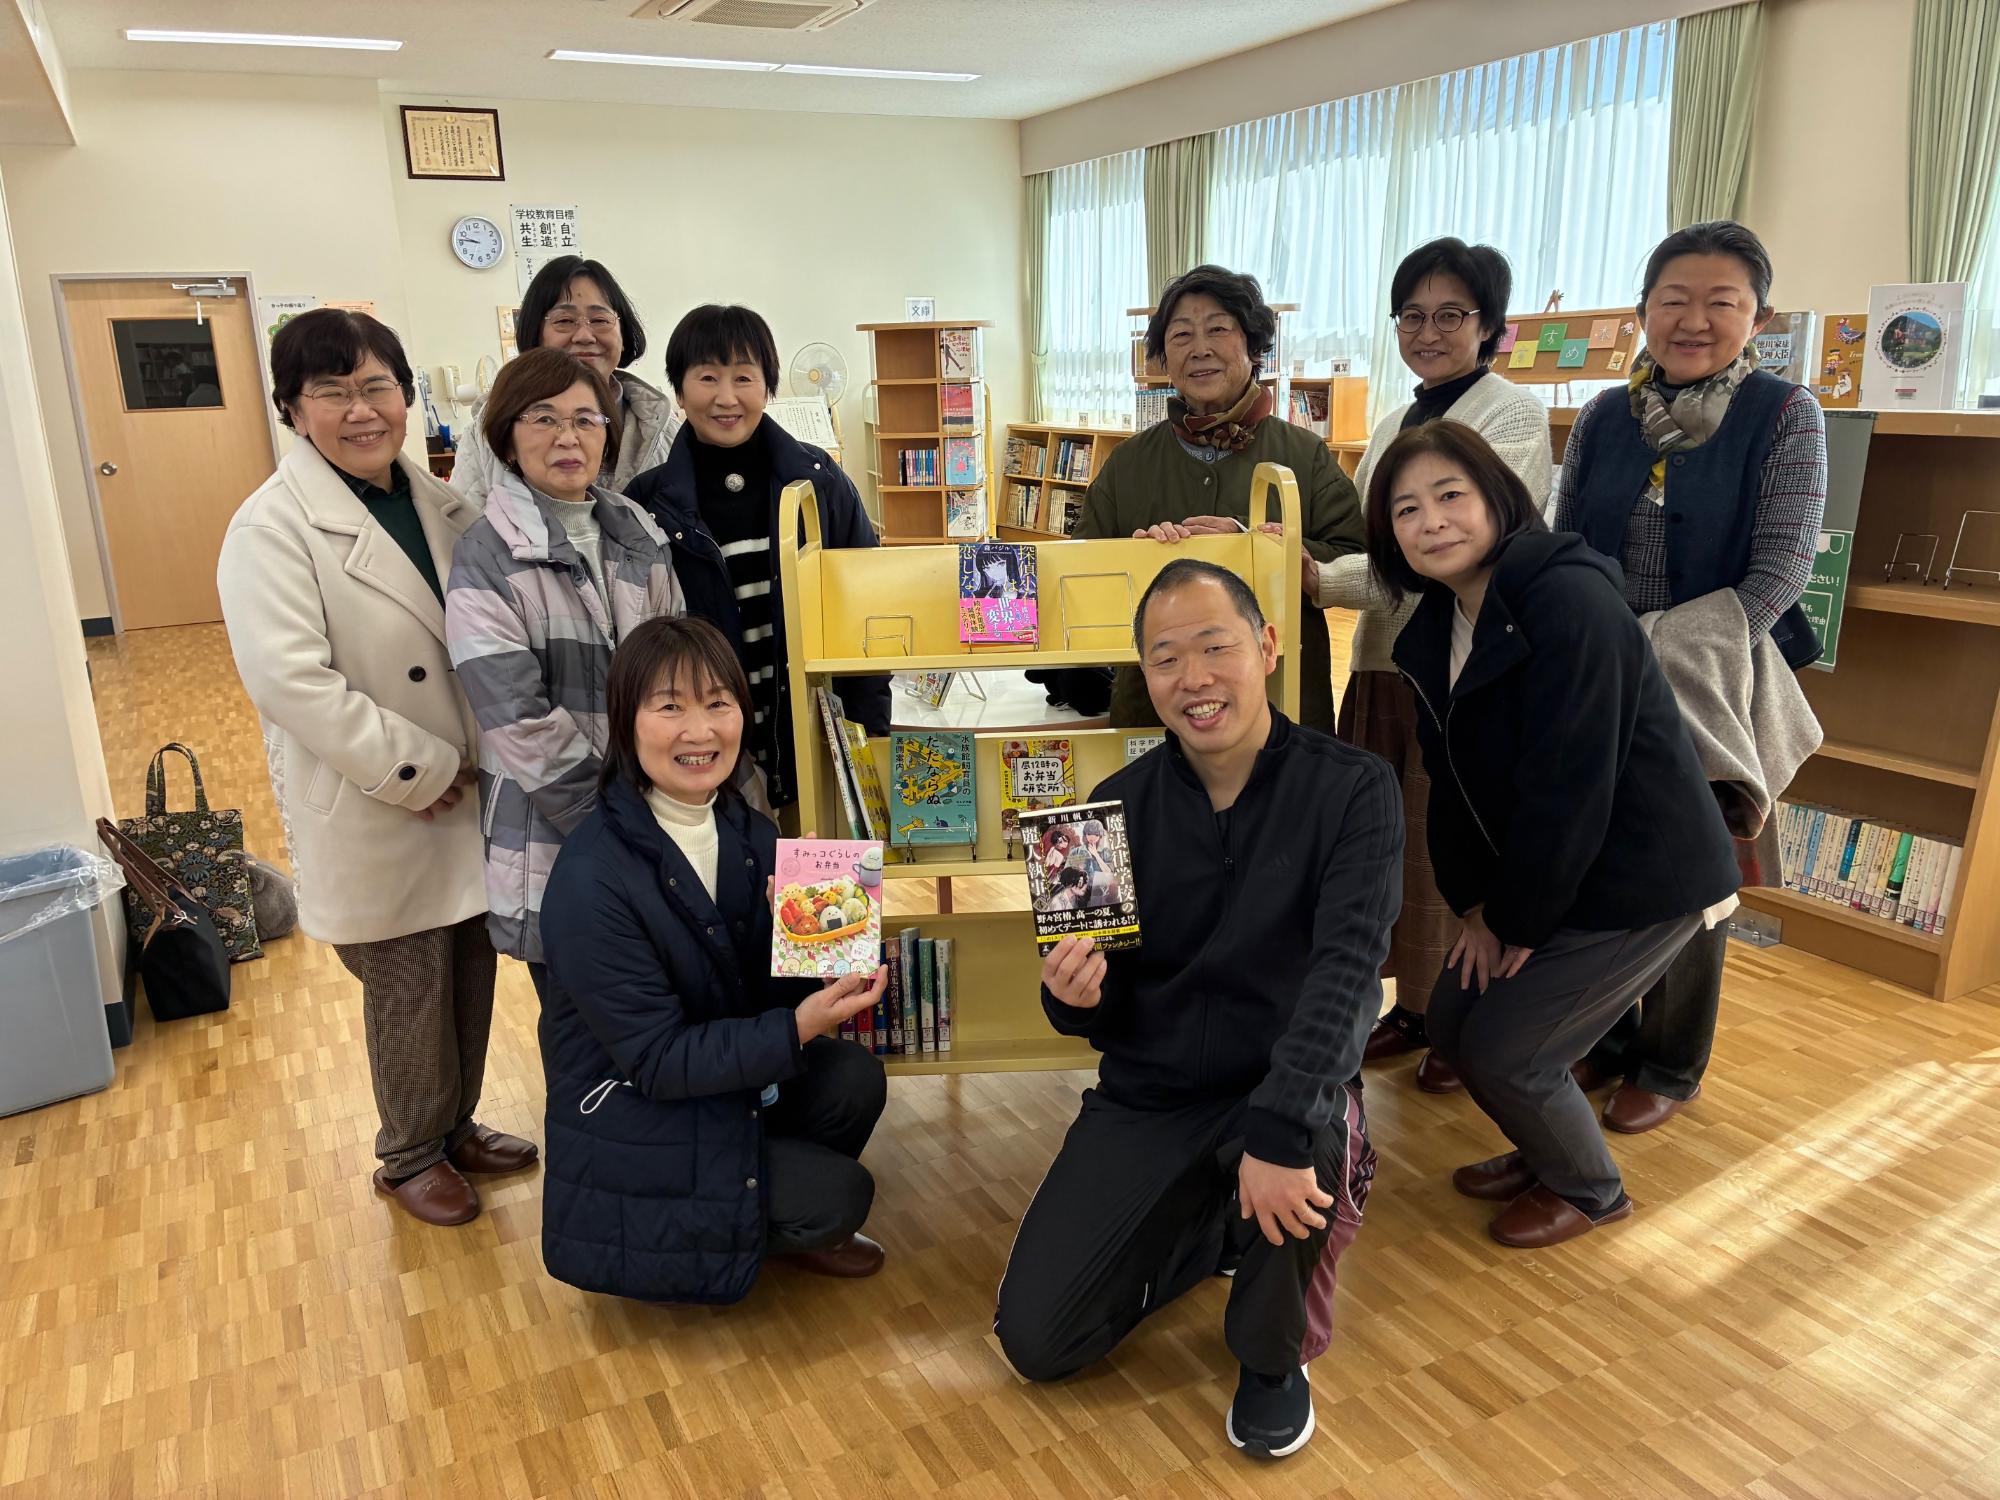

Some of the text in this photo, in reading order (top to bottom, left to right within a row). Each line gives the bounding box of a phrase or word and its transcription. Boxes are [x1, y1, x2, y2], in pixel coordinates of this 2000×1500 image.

[515, 209, 575, 220] 学校教育目標
[519, 222, 534, 247] 共生
[539, 222, 554, 247] 創造
[561, 222, 573, 247] 自立
[912, 305, 930, 317] 文庫
[1756, 340, 1790, 349] 徳川家康
[959, 544, 977, 601] 恋しない
[1018, 545, 1037, 607] 探偵小石
[926, 735, 942, 805] ただならぬ
[961, 735, 971, 796] 水族館飼育員の
[1021, 760, 1059, 769] 昼12時の
[1023, 770, 1057, 781] お弁当
[1022, 783, 1060, 793] 研究所
[1048, 810, 1095, 825] 新川帆立
[793, 848, 860, 859] すみっコぐらしの
[1022, 826, 1046, 896] 麗人執事
[1106, 813, 1134, 913] 魔法律学校の
[815, 860, 840, 870] お弁当
[1037, 906, 1115, 924] 野々宮椿。高一の夏、
[1039, 914, 1136, 936] 初めてデートに誘われる!?
